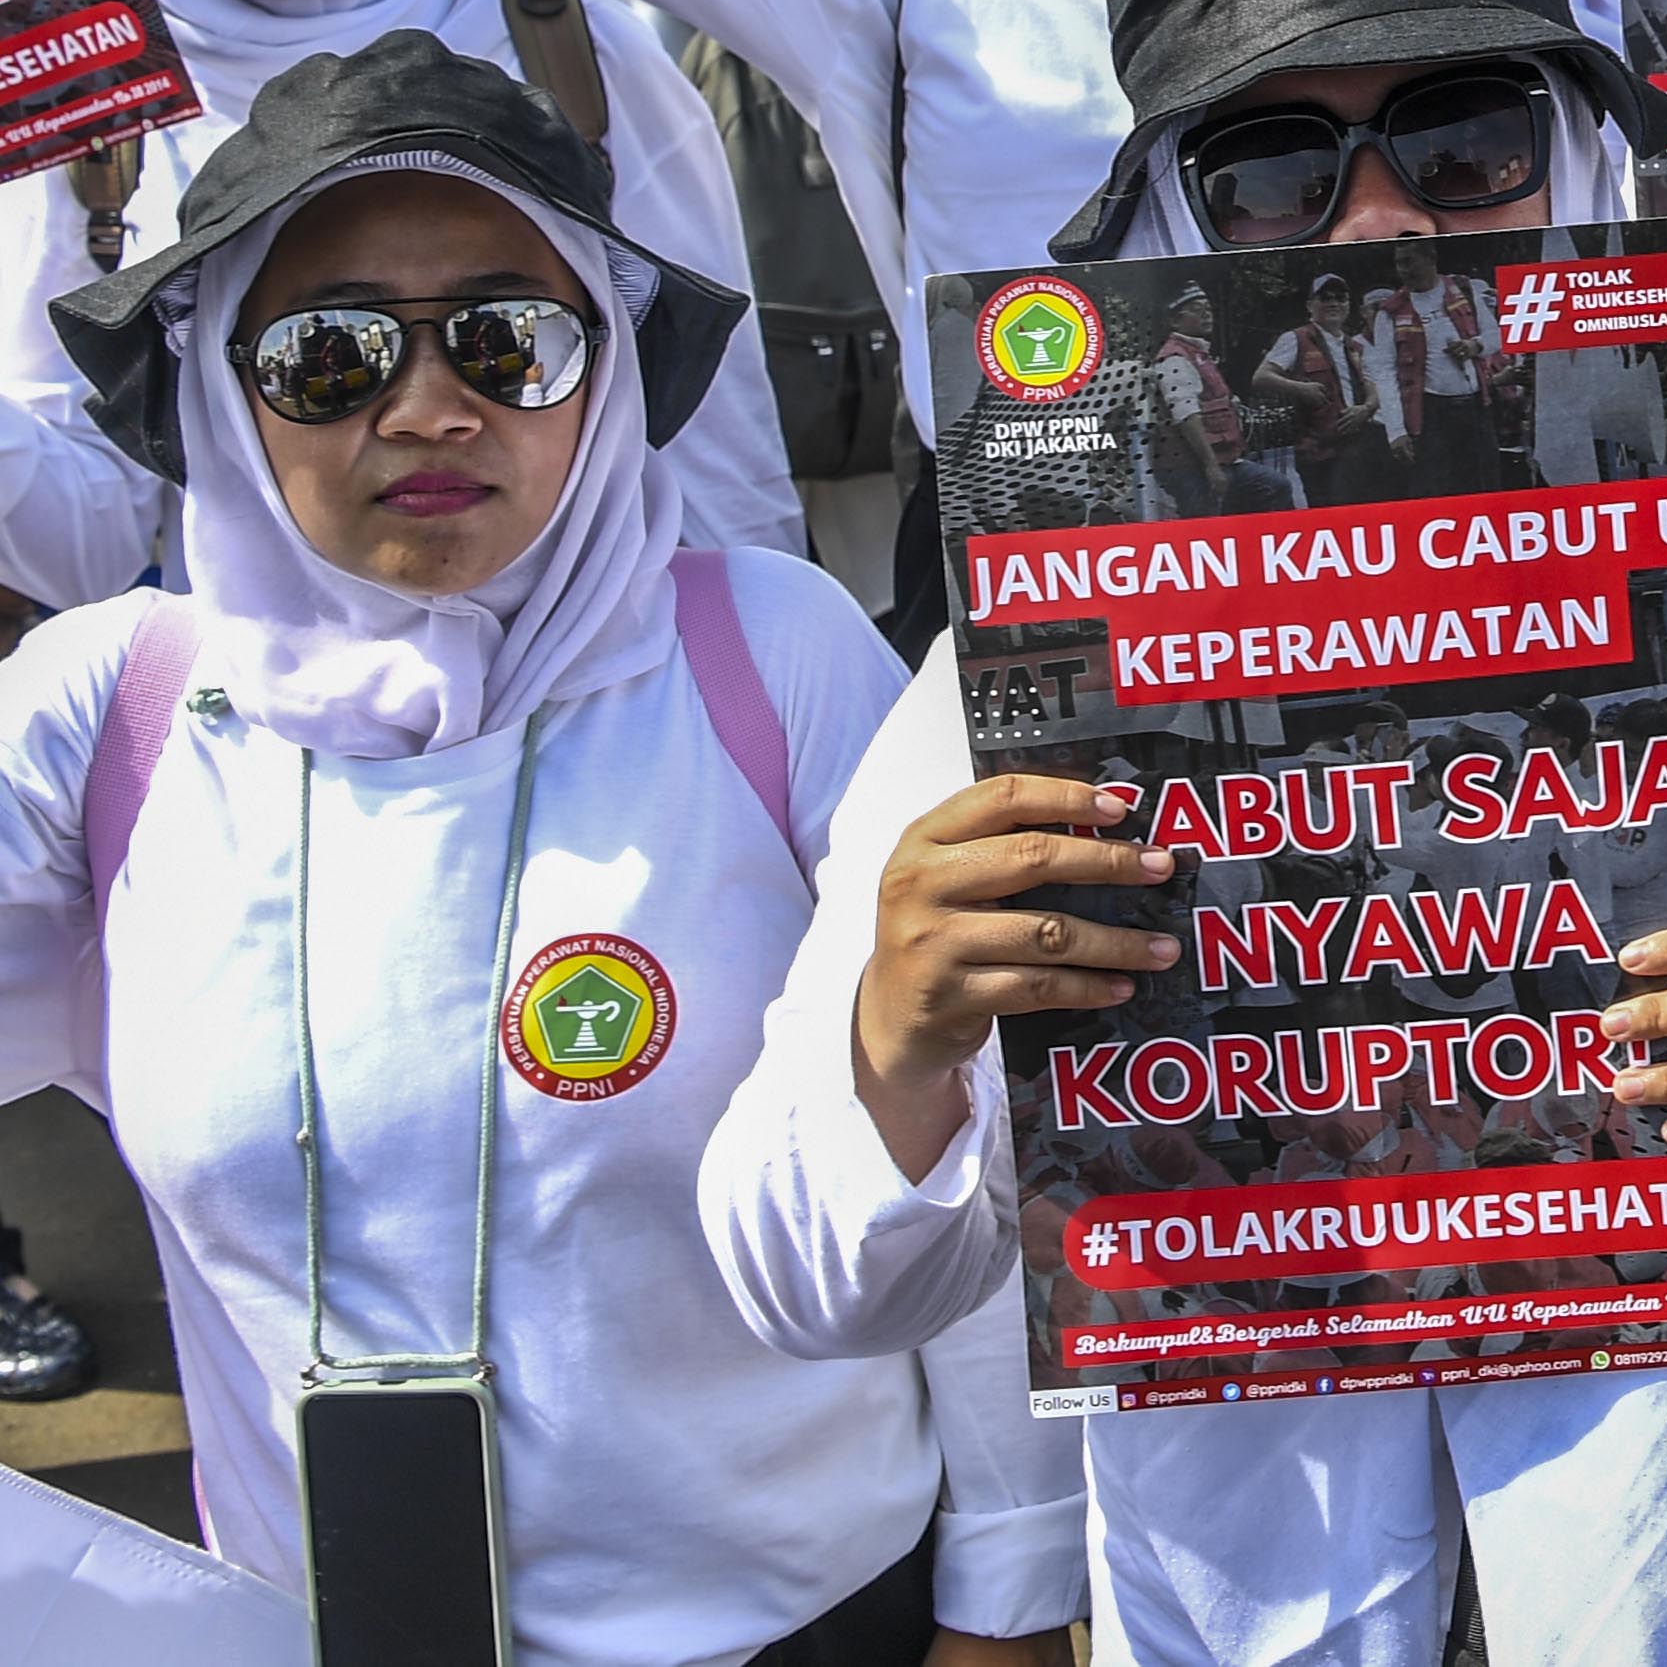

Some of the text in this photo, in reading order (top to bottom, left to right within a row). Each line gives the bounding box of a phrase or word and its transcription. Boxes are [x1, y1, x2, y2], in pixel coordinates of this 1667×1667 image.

[1565, 269, 1633, 289] TOLAK
[1023, 384, 1066, 400] PPNI
[985, 432, 1118, 460] DKI JAKARTA
[994, 417, 1098, 440] DPW PPNI
[968, 537, 1239, 622] JANGAN
[1261, 523, 1398, 582] KAU
[1417, 501, 1637, 571] CABUT
[1116, 596, 1610, 689] KEPERAWATAN
[1193, 879, 1615, 993] NYAWA
[508, 940, 669, 1071] PERSATUAN PERAWAT NASIONAL INDONESIA
[555, 1078, 615, 1098] PPNI
[1327, 1307, 1455, 1334] Selamatkan
[1460, 1304, 1506, 1325] UU
[1512, 1289, 1661, 1325] Keperawatan
[1033, 1396, 1084, 1413] Follow
[1089, 1394, 1110, 1407] Us
[1441, 1357, 1581, 1383] ppni_dki@yahoo.com
